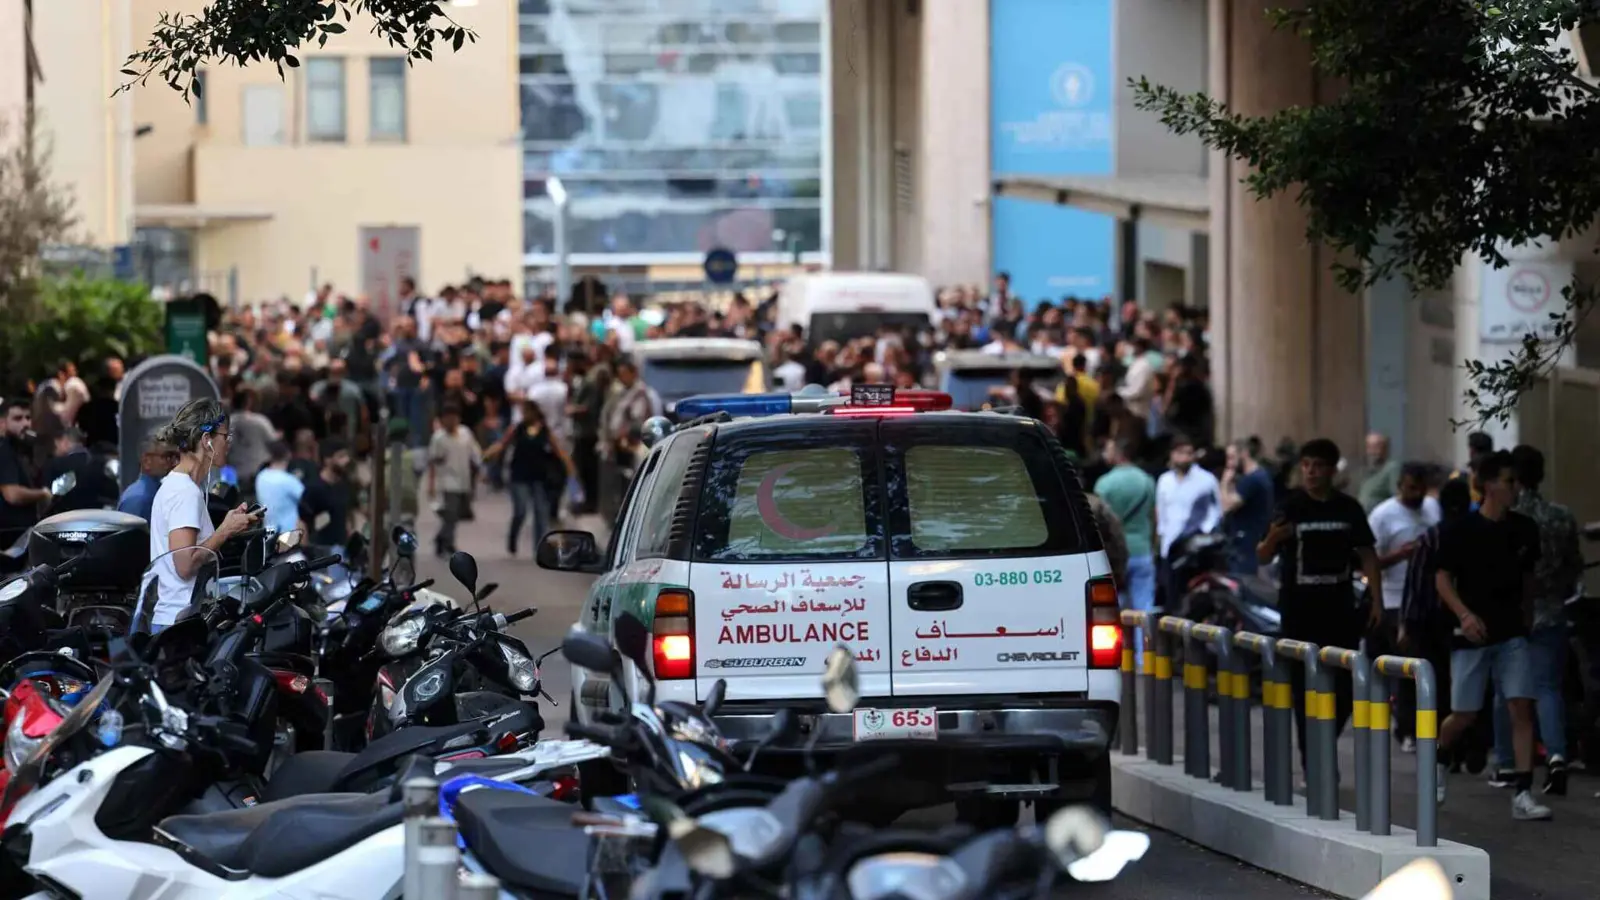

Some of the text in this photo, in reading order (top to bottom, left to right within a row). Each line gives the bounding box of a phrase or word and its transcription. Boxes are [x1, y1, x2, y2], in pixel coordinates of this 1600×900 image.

[720, 569, 866, 593] جمعية الرسالة
[974, 570, 1063, 586] 03-880 052
[720, 595, 866, 622] للإسعاف الصحي
[717, 621, 870, 645] AMBULANCE
[723, 656, 807, 668] SUBURBAN
[901, 646, 958, 667] الدفاع
[996, 651, 1080, 662] CHEVROLET
